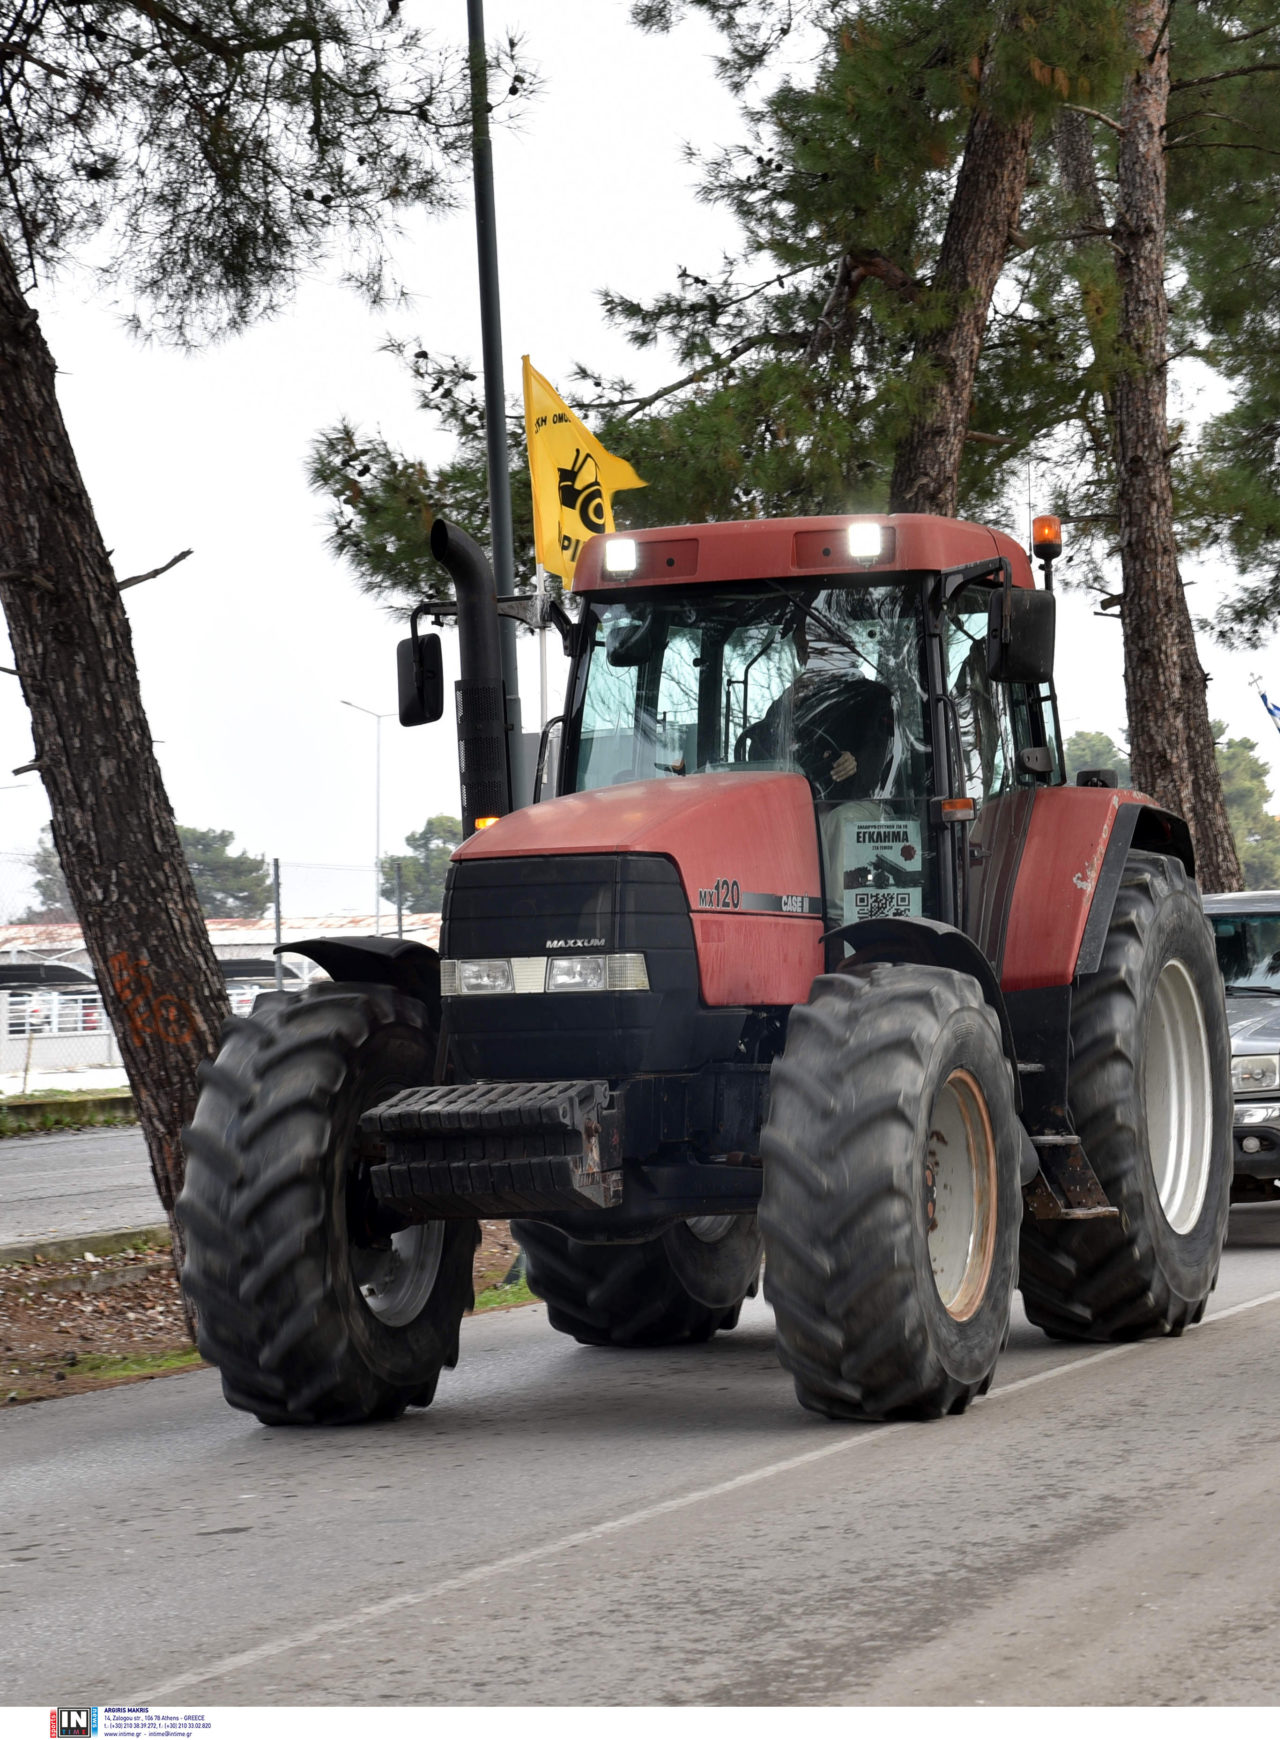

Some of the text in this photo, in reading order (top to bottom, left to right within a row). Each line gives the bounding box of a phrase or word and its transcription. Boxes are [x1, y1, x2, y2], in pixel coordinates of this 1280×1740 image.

[856, 831, 909, 843] ΕΓΚΛΗΜΑ
[699, 878, 740, 909] MX120
[781, 895, 802, 913] CASE
[545, 938, 606, 949] MAXXUM
